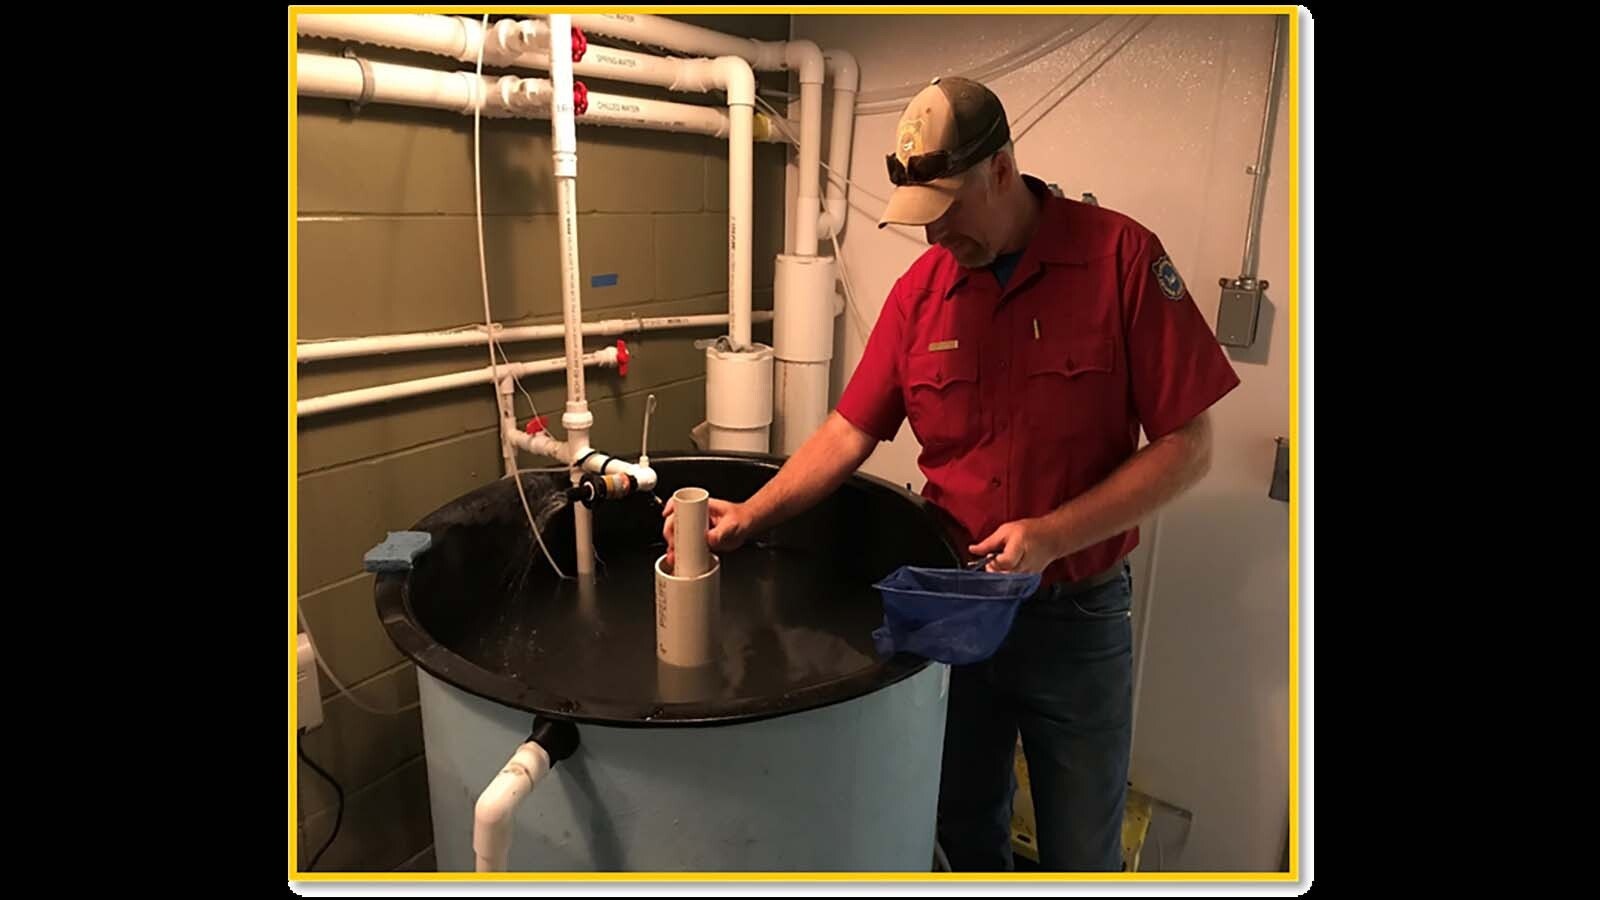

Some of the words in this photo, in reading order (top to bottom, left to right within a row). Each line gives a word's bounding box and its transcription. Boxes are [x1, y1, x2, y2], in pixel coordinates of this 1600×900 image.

[596, 54, 618, 65] SPRING
[618, 58, 637, 67] WATER
[597, 101, 620, 112] CHILLED
[621, 104, 640, 113] WATER
